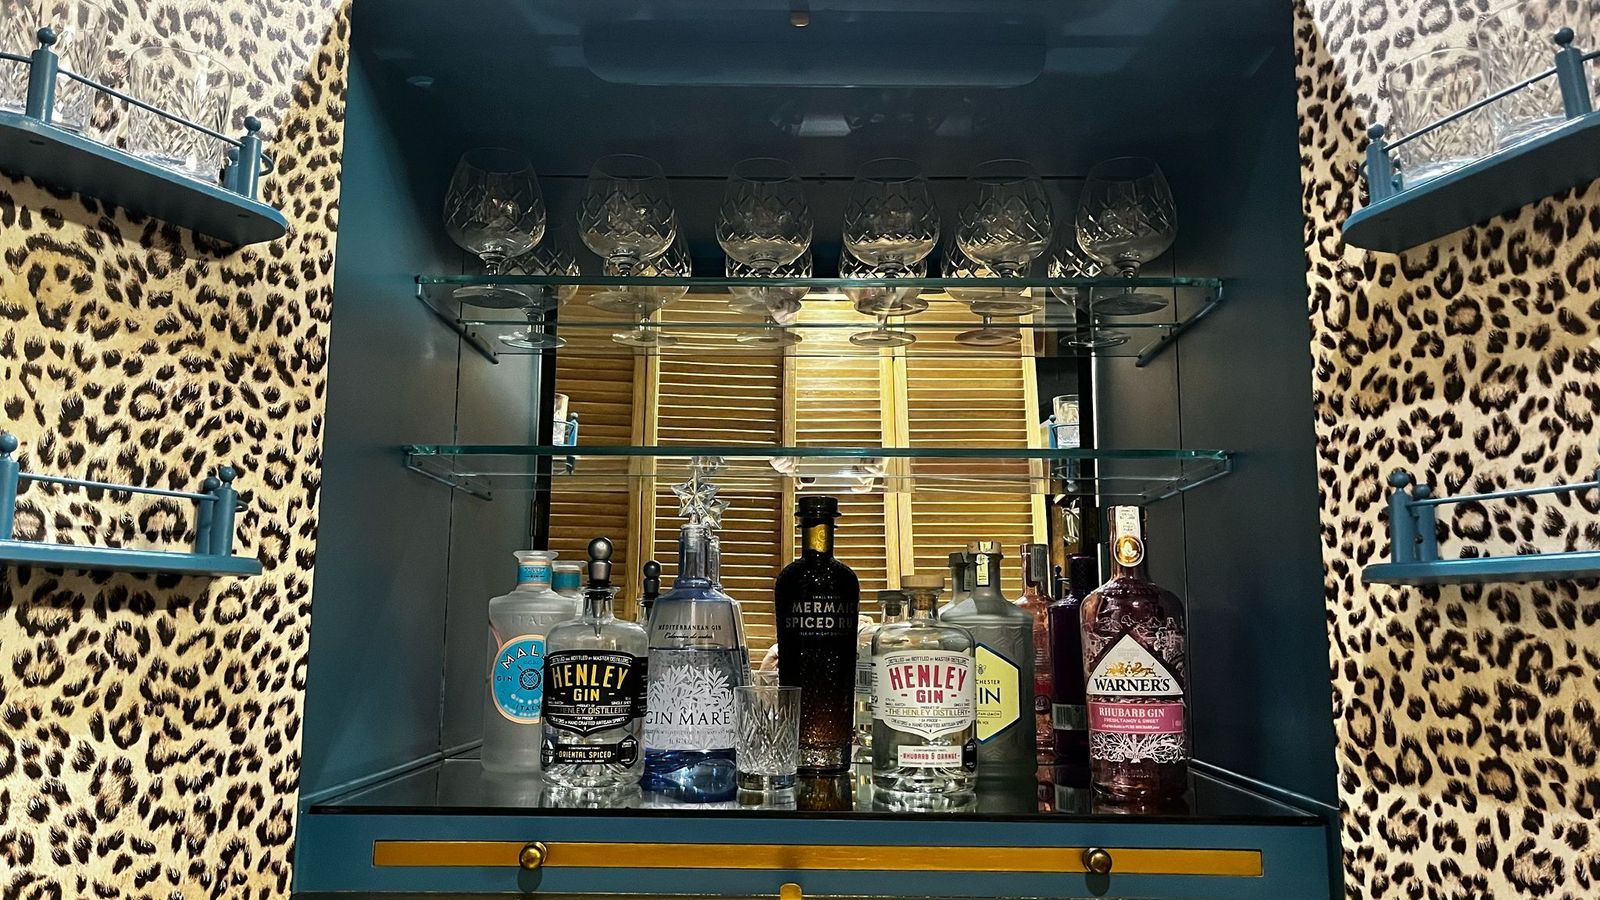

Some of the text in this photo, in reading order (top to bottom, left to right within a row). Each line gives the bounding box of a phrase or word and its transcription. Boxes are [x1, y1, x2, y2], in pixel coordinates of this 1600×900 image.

[785, 616, 853, 629] SPICED RU
[501, 644, 543, 670] MAL
[552, 663, 628, 689] HENLEY
[889, 664, 967, 691] HENLEY
[1094, 678, 1170, 692] WARNER'S
[573, 688, 600, 702] GIN
[916, 689, 944, 704] GIN
[979, 687, 1001, 705] IN
[587, 707, 628, 715] DISTILLERY
[646, 710, 731, 726] GIN MARE
[902, 708, 931, 716] HENLEY
[933, 709, 968, 717] DISTILLERY
[1098, 707, 1165, 718] RHUBARB GIN
[558, 750, 587, 759] ORIENTAL
[588, 750, 612, 759] SPICED
[902, 752, 929, 760] RHUBARB
[936, 752, 957, 760] ORANGE
